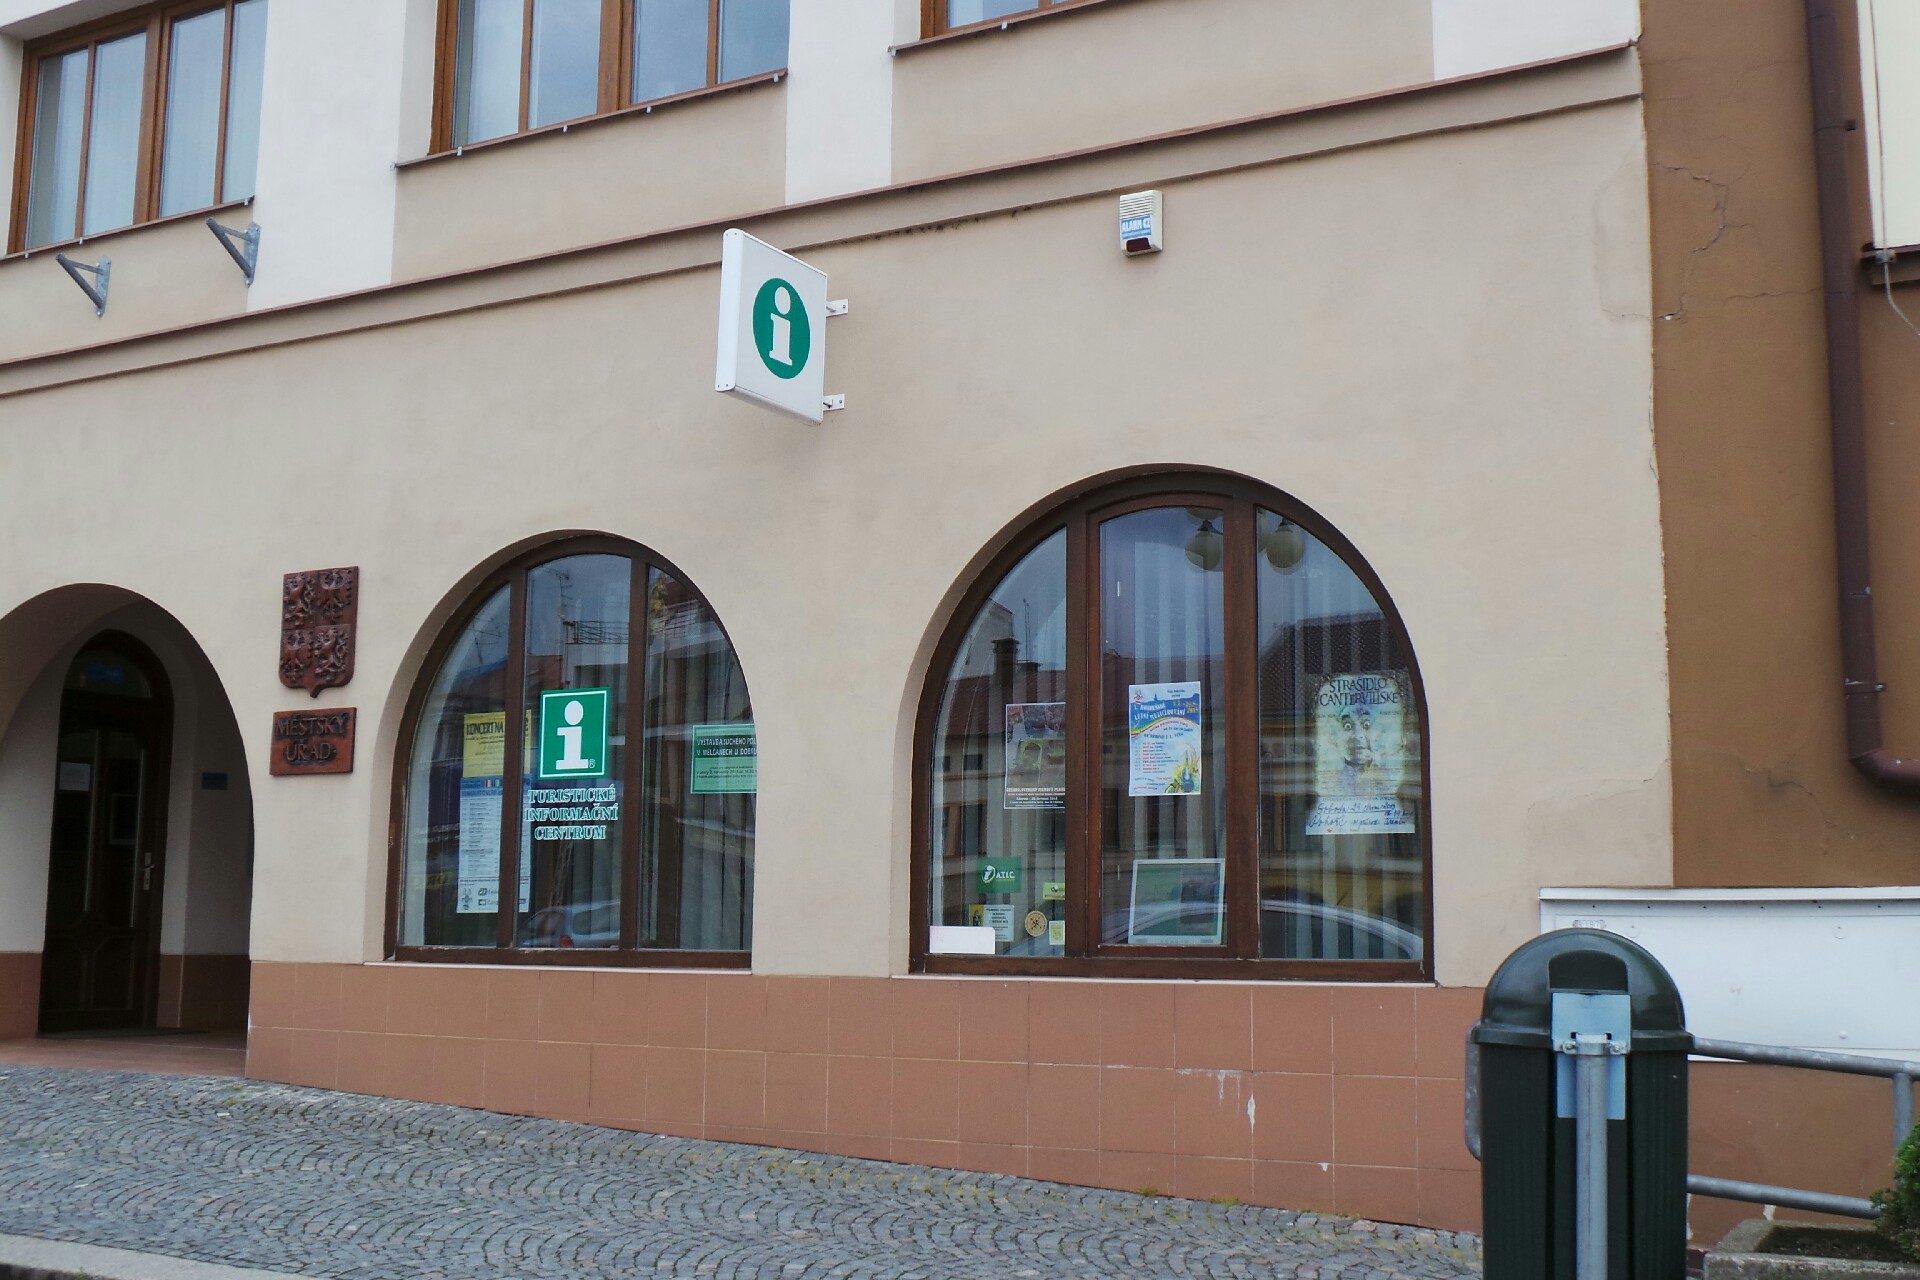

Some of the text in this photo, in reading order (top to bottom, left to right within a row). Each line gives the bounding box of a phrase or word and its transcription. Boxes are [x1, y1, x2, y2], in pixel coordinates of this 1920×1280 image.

[527, 784, 616, 804] TURISTICKÉ
[524, 803, 619, 821] INFORMAČNÍ
[534, 825, 607, 840] CENTRUM
